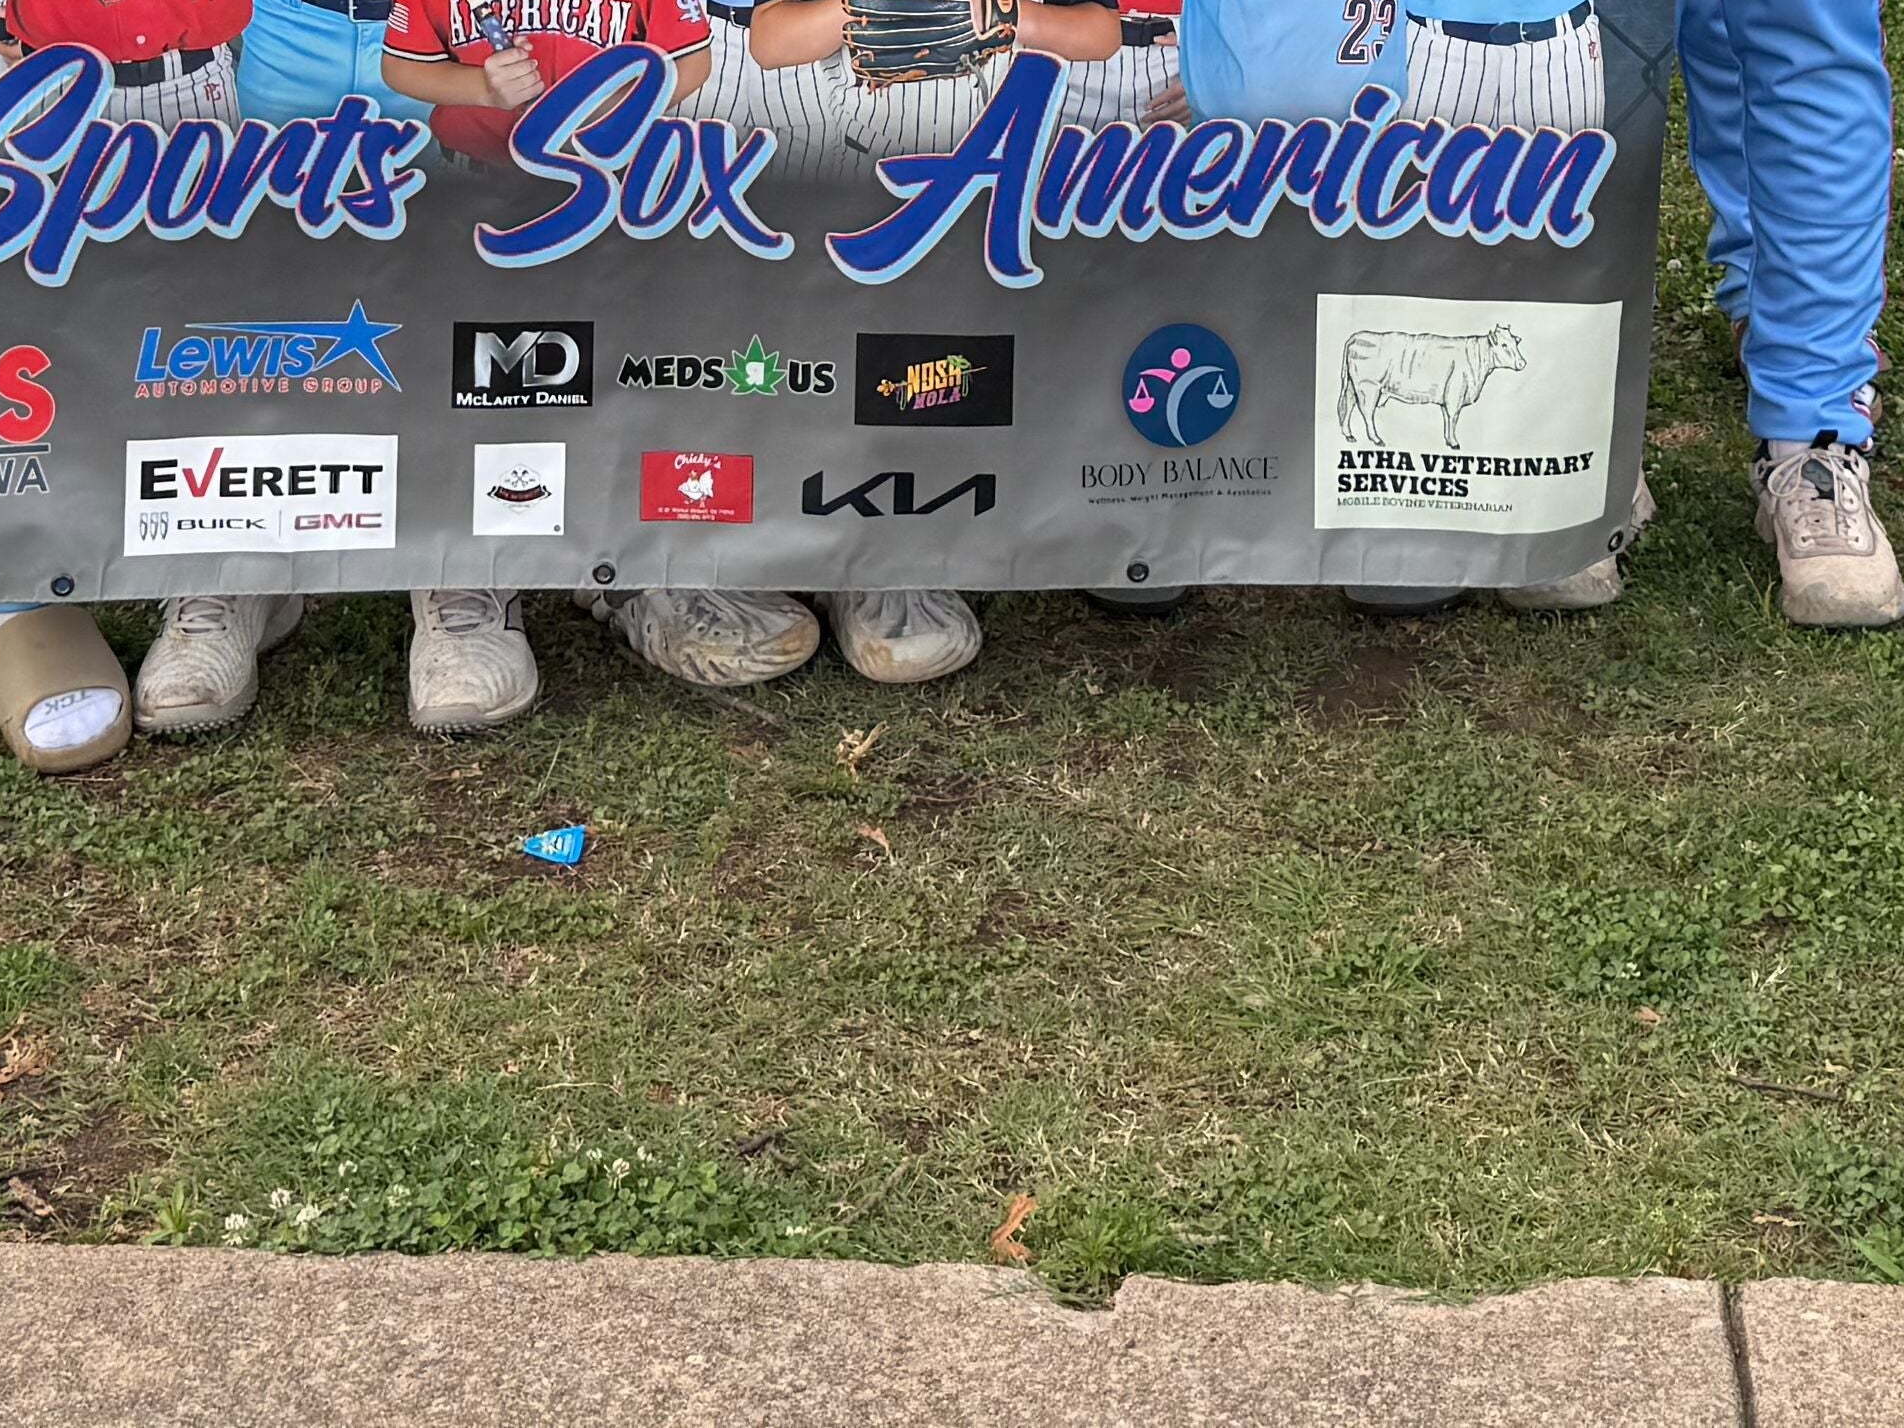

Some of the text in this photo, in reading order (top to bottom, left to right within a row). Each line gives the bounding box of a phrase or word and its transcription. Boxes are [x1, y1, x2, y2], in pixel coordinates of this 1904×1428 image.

[473, 41, 794, 268] Sox
[824, 47, 1617, 288] American
[474, 331, 581, 389] MD
[617, 352, 726, 392] MEDS
[787, 358, 837, 396] US
[134, 376, 384, 399] AUTOMOTIVE GROUP
[1081, 455, 1279, 489] BODY BALANCE
[1337, 450, 1595, 477] ATHA VETERINARY
[1337, 473, 1470, 498] SERVICES
[1336, 496, 1381, 507] MOBILE
[1382, 498, 1426, 509] BOVINE
[177, 518, 267, 531] BUICK
[293, 512, 383, 531] GMC
